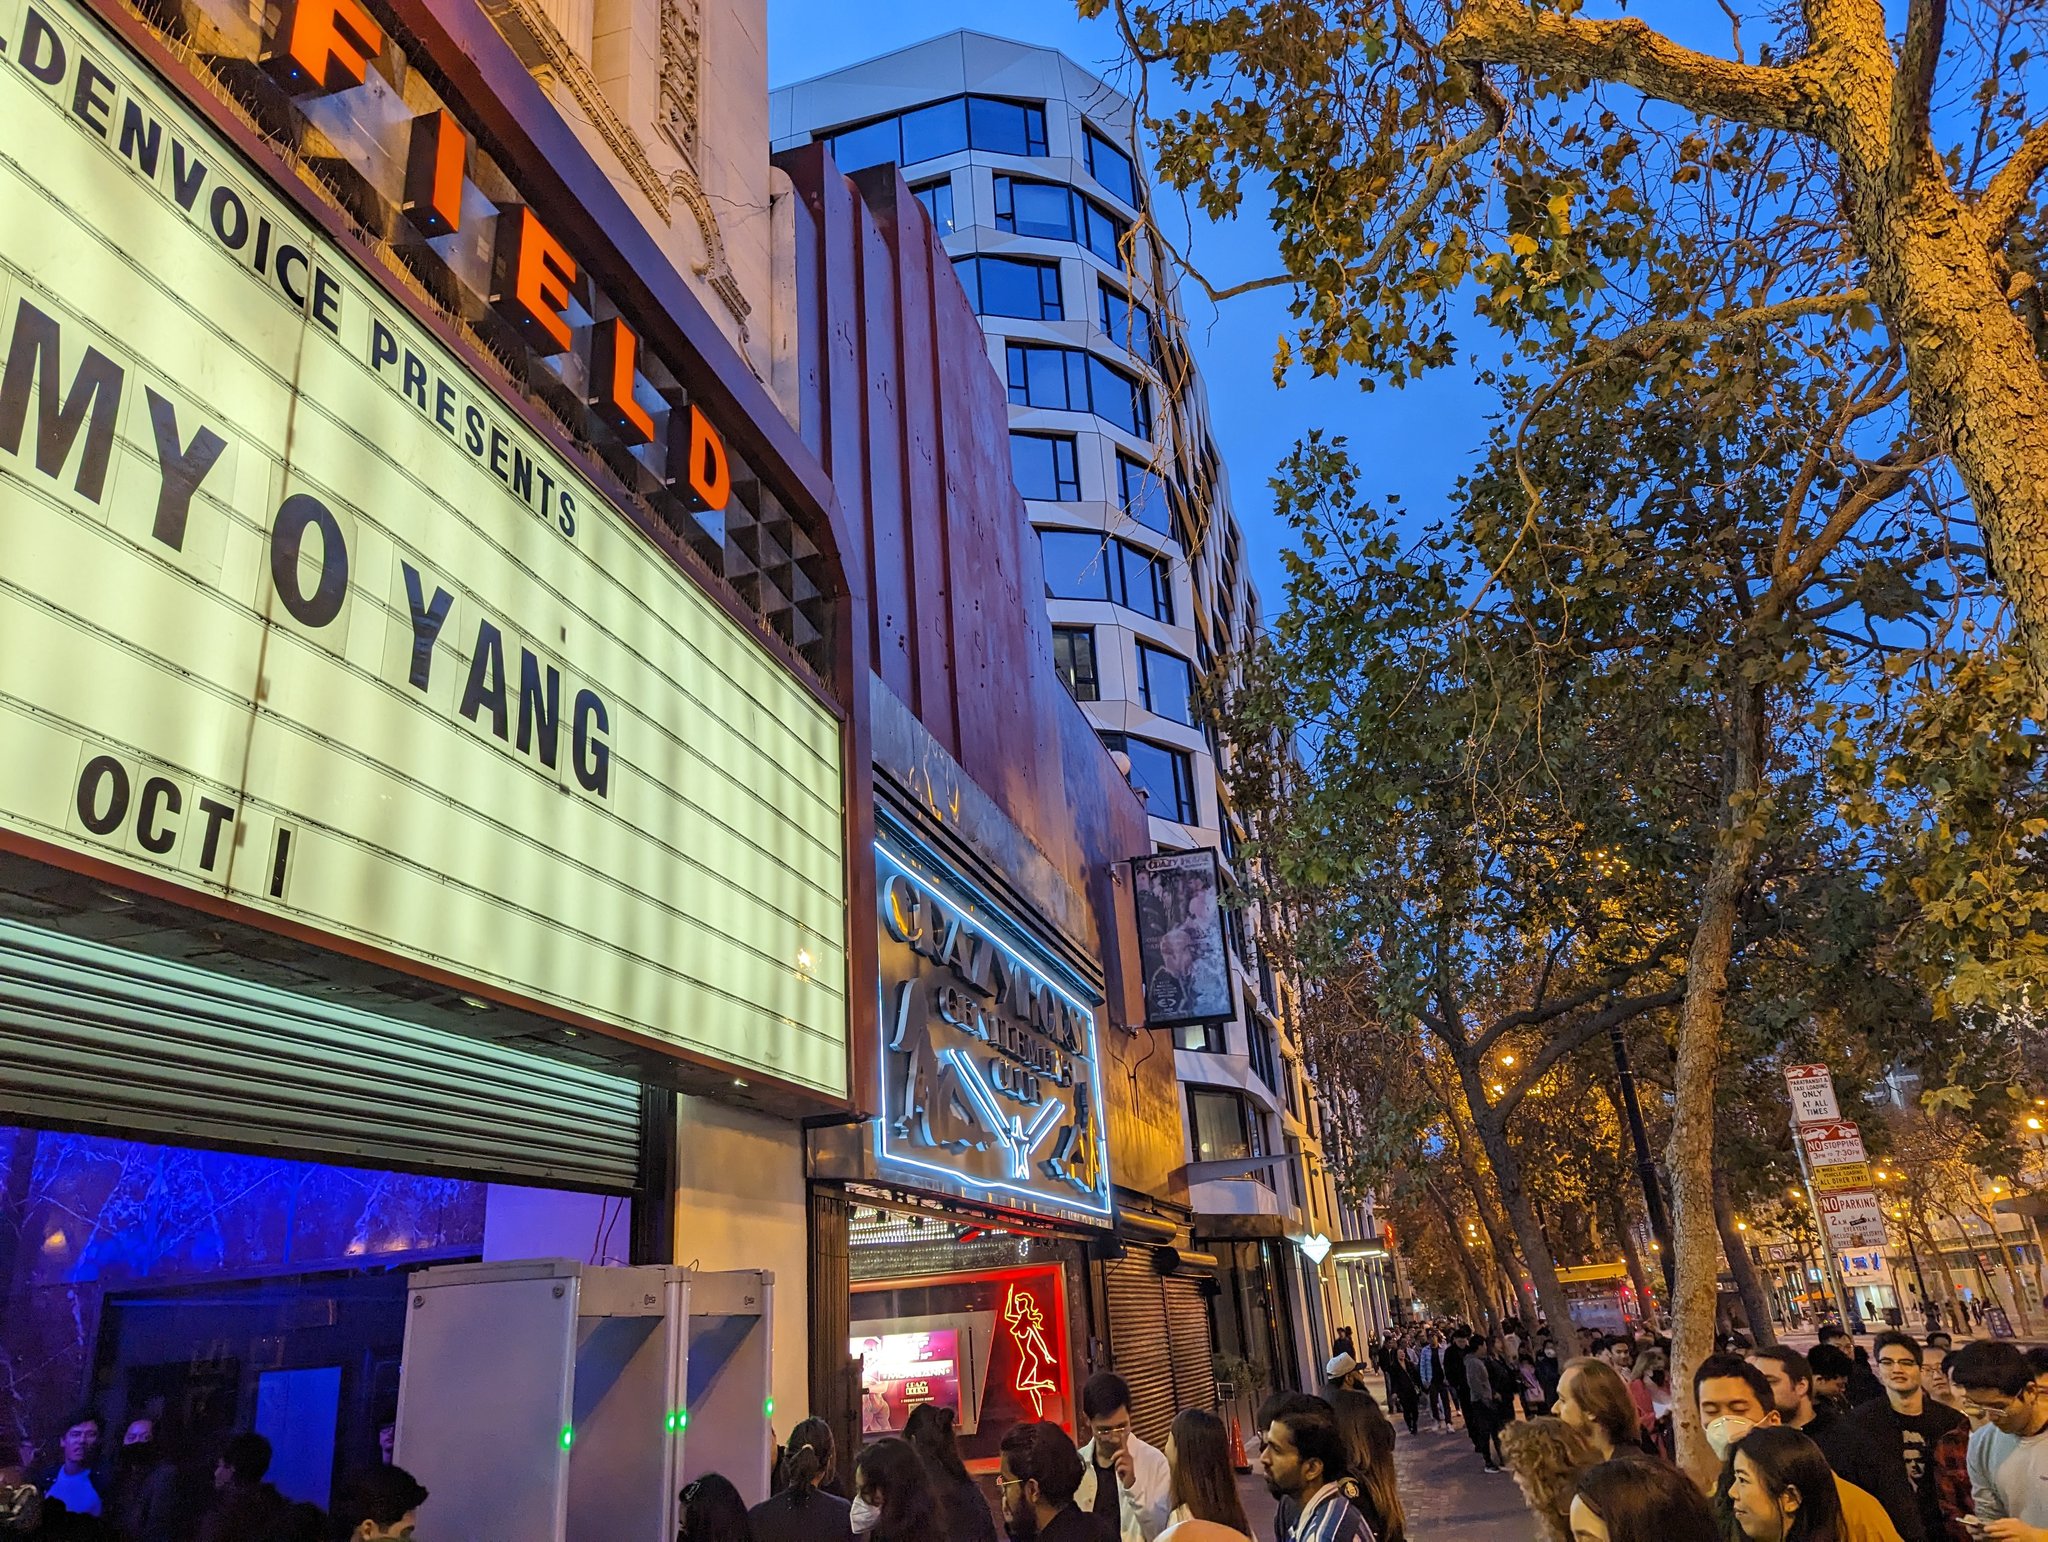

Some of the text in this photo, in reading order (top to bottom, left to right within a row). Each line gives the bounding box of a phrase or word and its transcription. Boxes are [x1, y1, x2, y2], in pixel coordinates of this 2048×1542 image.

[0, 5, 577, 538] DENVOICE PRESENTS
[271, 493, 349, 628] O
[400, 558, 611, 800] YANG
[76, 755, 235, 872] OCT
[988, 1056, 1043, 1107] CLUB
[1802, 1090, 1822, 1098] ONLY
[1802, 1101, 1811, 1109] AT
[1806, 1140, 1860, 1151] NO STOPPING
[1820, 1178, 1831, 1186] ALL
[1821, 1197, 1876, 1212] NO PARKING
